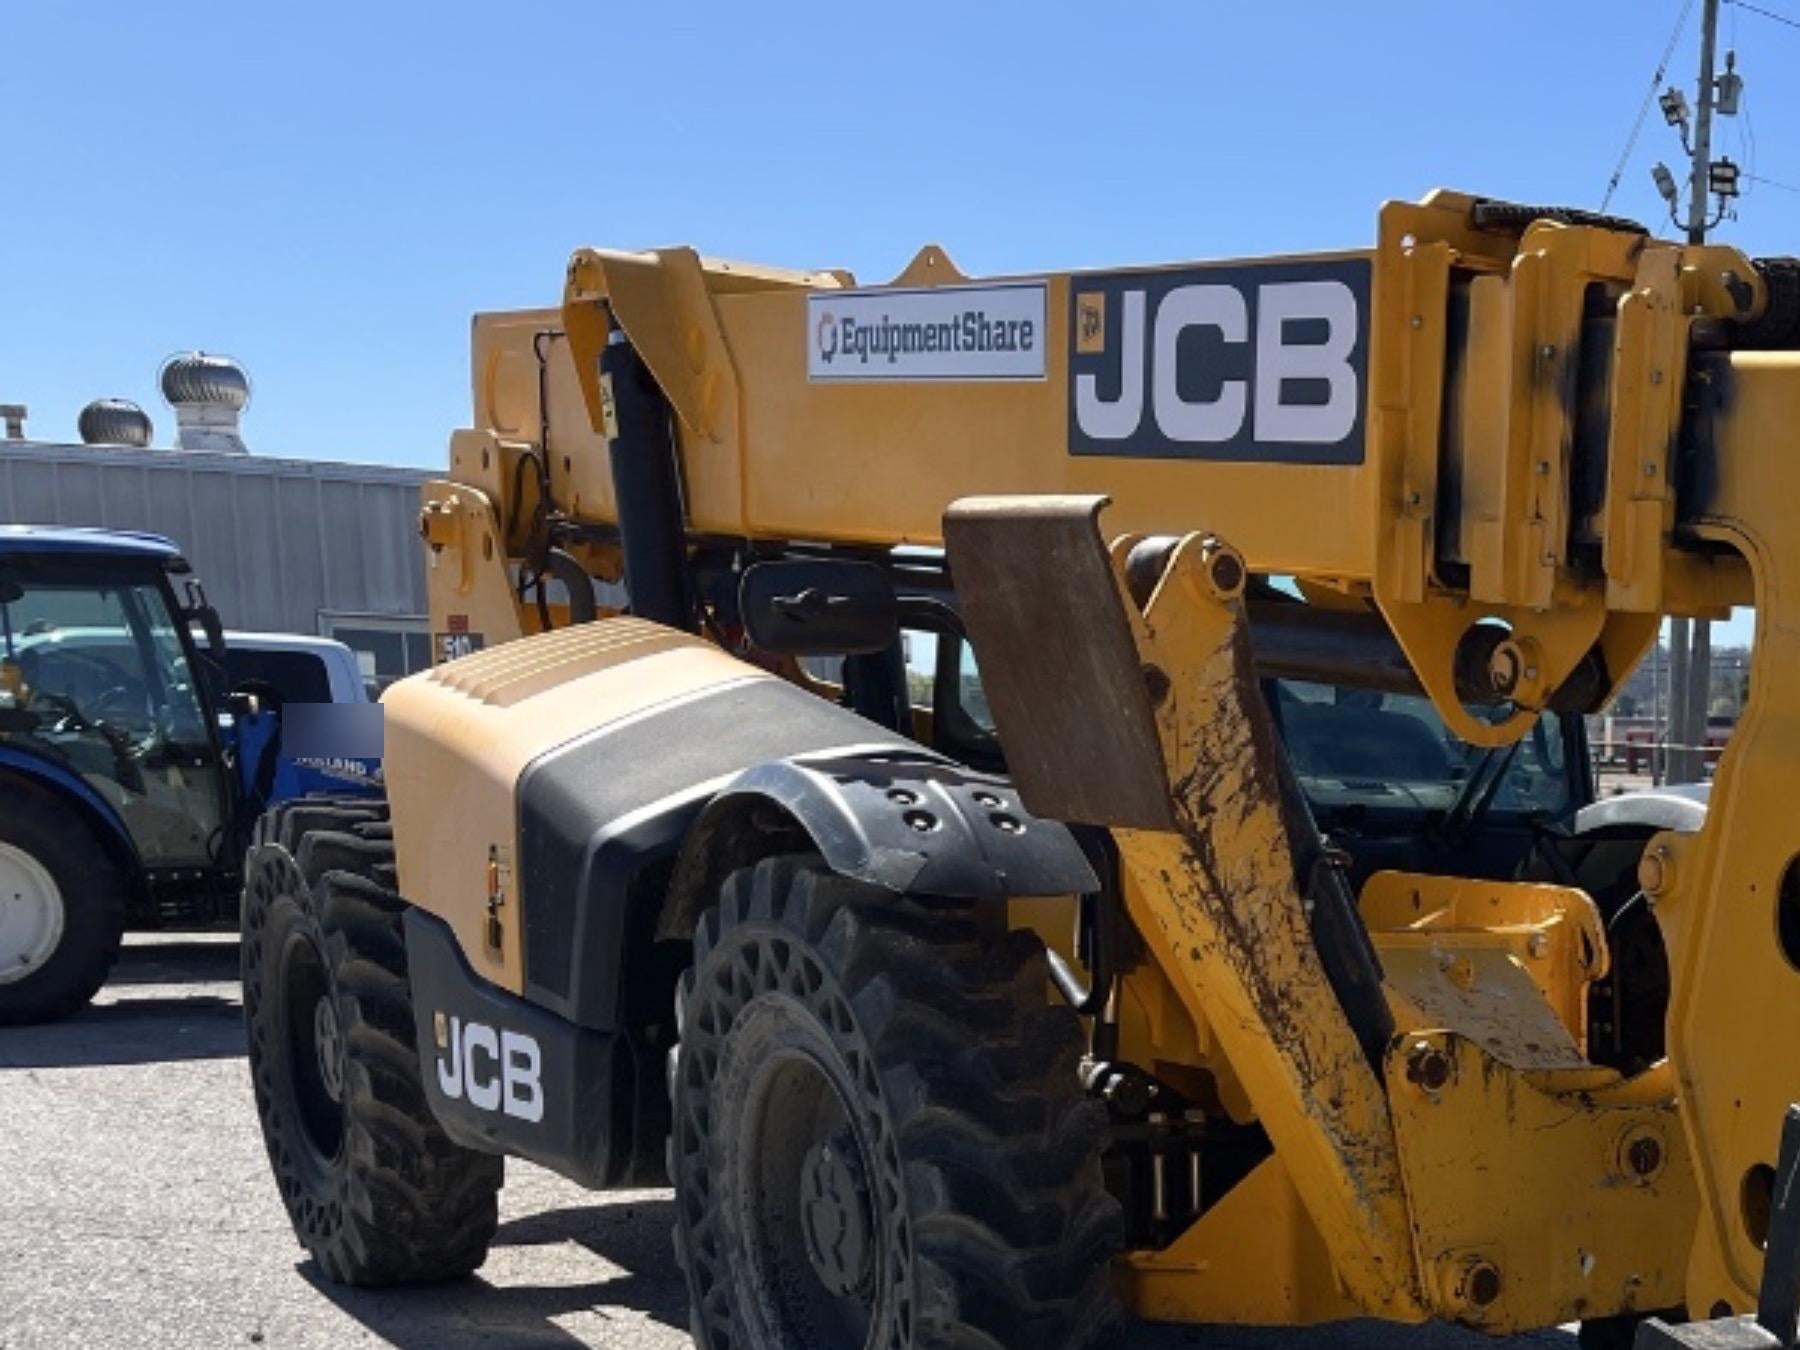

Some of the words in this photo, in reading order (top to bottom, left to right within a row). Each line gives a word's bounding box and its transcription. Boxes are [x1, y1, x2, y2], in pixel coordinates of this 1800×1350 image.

[840, 311, 1034, 364] EquipmentShare
[1074, 279, 1358, 443] JCB
[437, 1016, 544, 1123] JCB
